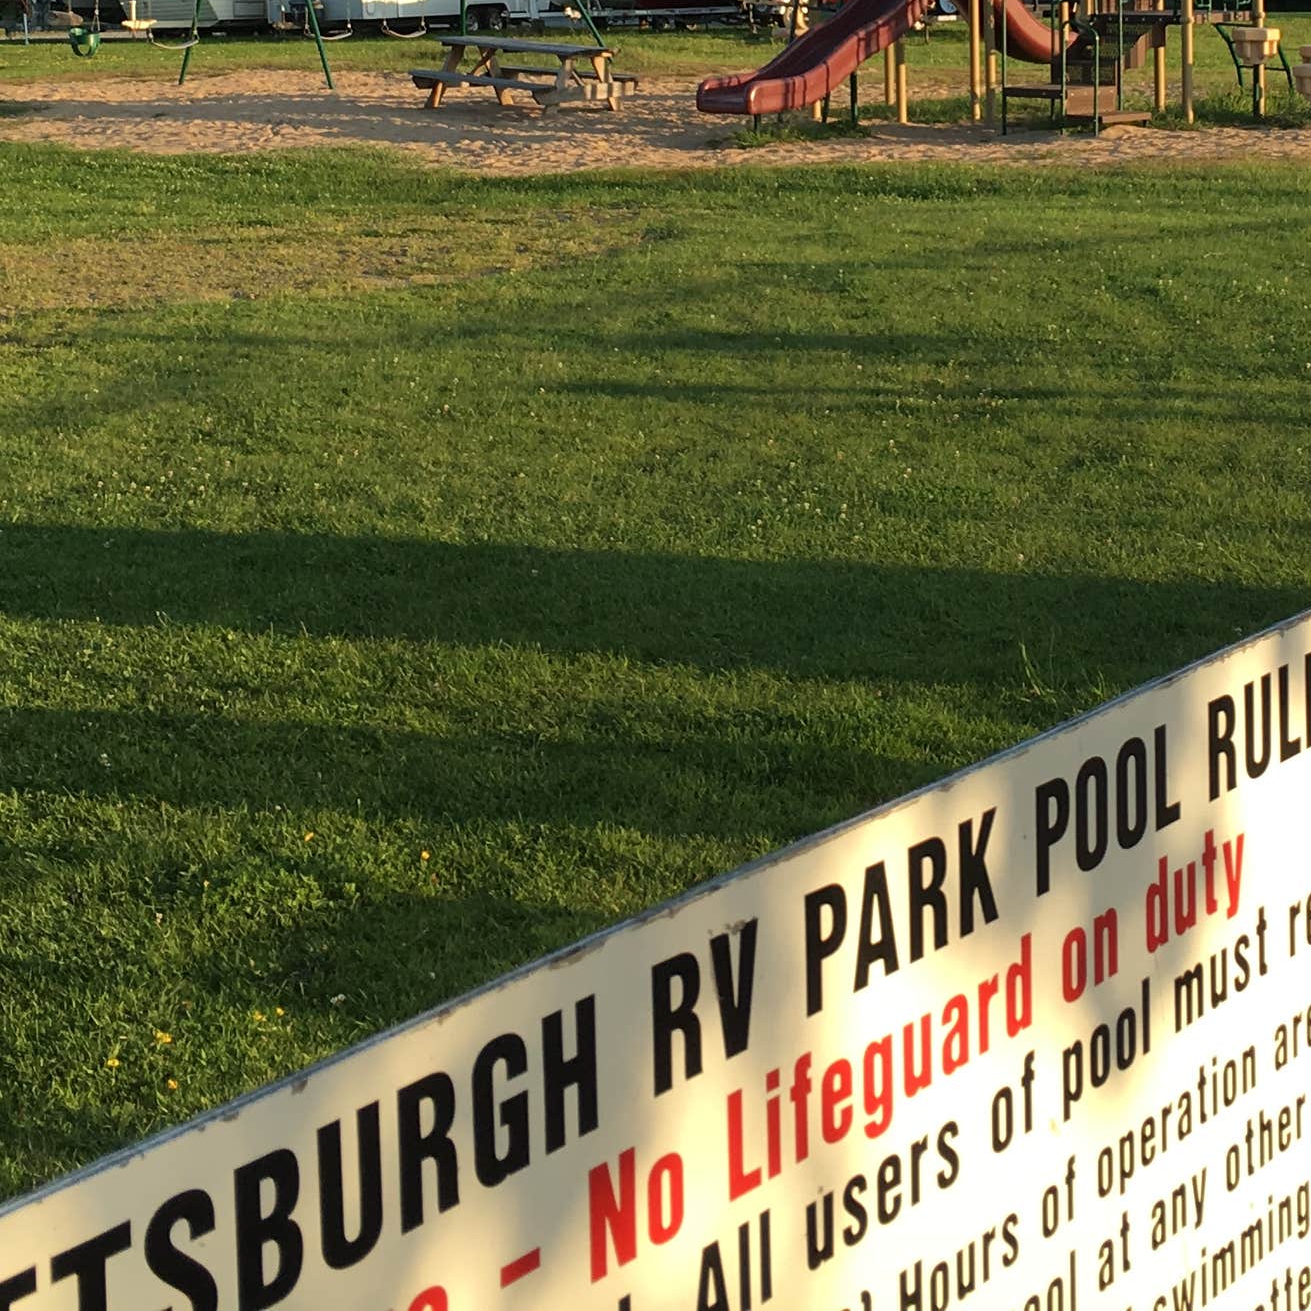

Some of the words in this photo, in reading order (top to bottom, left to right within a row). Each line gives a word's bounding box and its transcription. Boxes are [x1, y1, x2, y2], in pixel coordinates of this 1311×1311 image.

[588, 1146, 684, 1285] No
[726, 932, 1033, 1201] Lifeguard
[1062, 907, 1119, 1003] on
[1145, 829, 1245, 954] duty
[652, 917, 758, 1096] RV
[804, 806, 999, 1018] PARK
[1035, 723, 1181, 898] POOL
[697, 1207, 772, 1311] All
[806, 1120, 960, 1271] users
[991, 1050, 1035, 1153] of
[1062, 975, 1151, 1123] pool
[1174, 905, 1268, 1033] must
[899, 1211, 1019, 1311] Hours
[1042, 1153, 1076, 1238] of
[1097, 1045, 1256, 1198] operation
[1098, 1210, 1131, 1291] at
[1151, 1167, 1207, 1251] any
[1226, 1092, 1306, 1193] other
